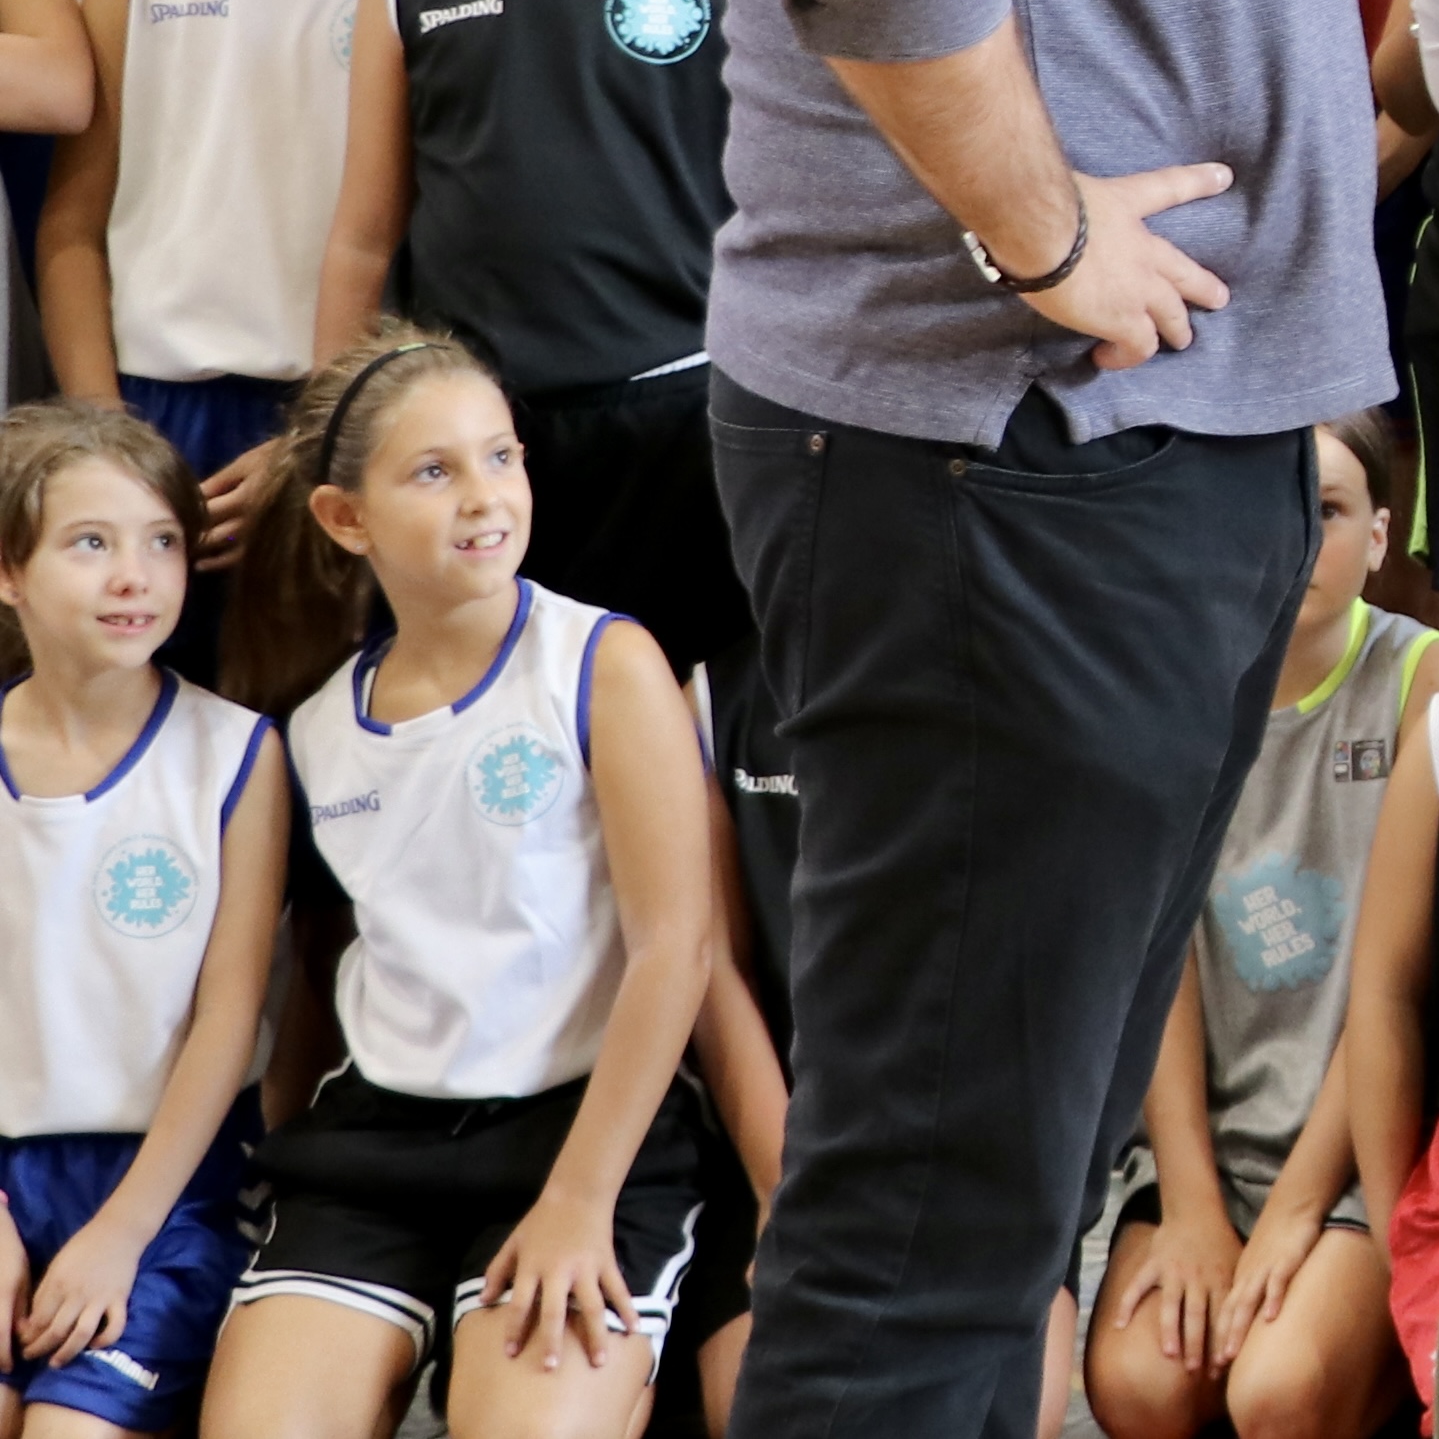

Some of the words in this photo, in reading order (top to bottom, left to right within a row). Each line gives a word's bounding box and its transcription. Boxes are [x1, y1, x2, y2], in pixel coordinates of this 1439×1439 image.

[1243, 885, 1278, 913] HER
[1261, 920, 1298, 947] HER
[1260, 933, 1316, 968] RULES
